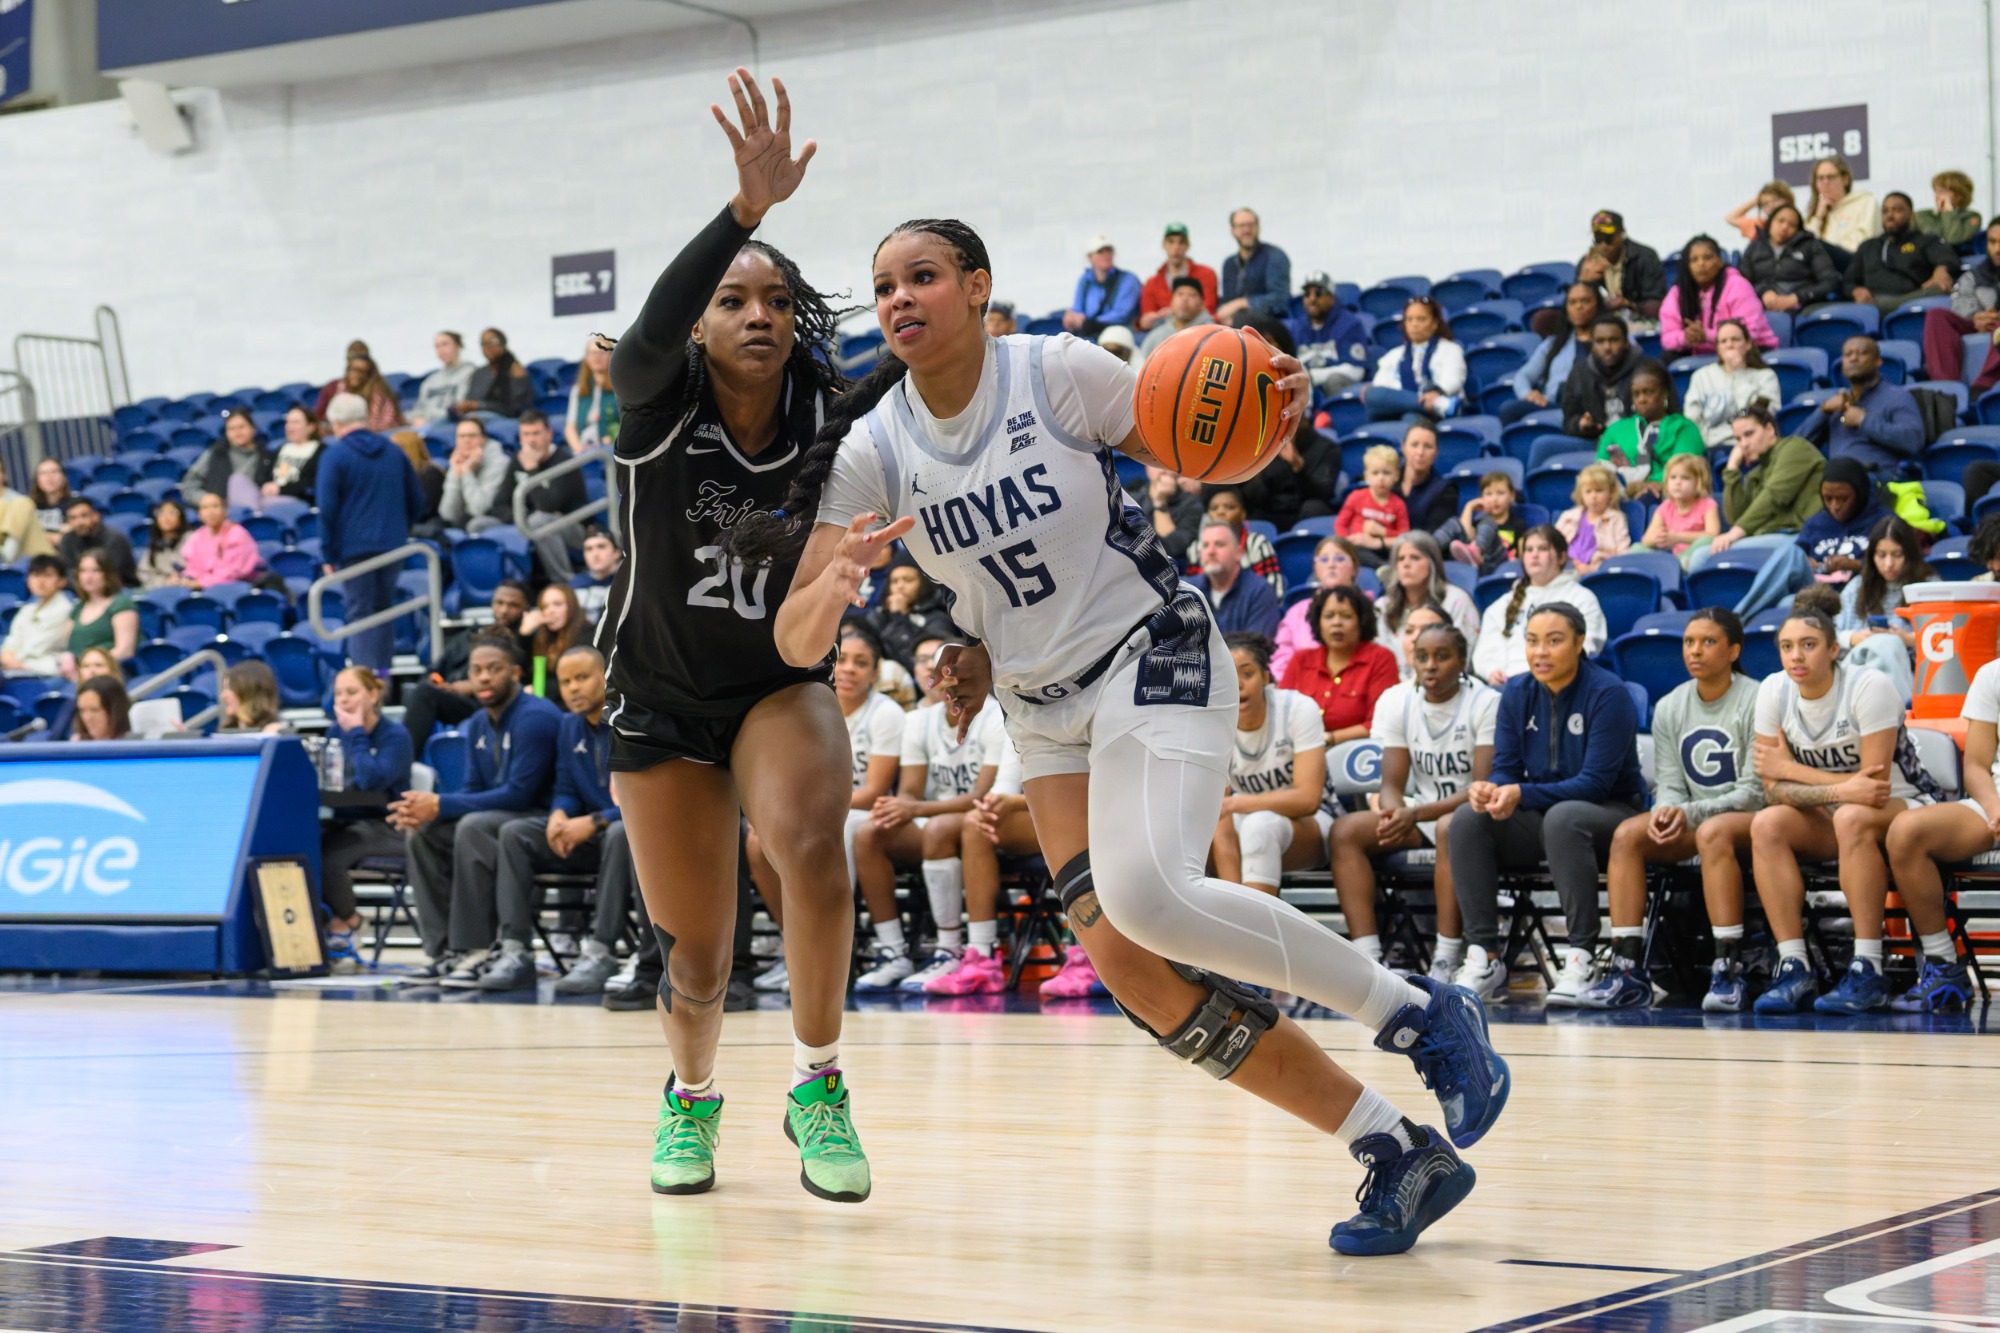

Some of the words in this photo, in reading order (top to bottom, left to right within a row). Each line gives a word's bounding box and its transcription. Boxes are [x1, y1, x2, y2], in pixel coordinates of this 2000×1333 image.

[1779, 132, 1837, 163] SEC.
[1843, 129, 1862, 156] 8
[597, 269, 612, 293] 7
[1190, 358, 1234, 446] ELITE
[698, 423, 709, 431] BE
[1007, 417, 1018, 427] BE
[1018, 411, 1033, 421] THE
[1007, 417, 1036, 435] CHANGE
[693, 430, 721, 441] CHANGE
[1010, 436, 1037, 452] EAST
[1011, 433, 1030, 445] BIG
[919, 463, 1062, 556] HOYAS
[687, 546, 773, 620] 20
[978, 538, 1057, 608] 15
[1922, 621, 1955, 663] G
[1042, 682, 1070, 699] G
[1414, 750, 1472, 777] HOYAS
[1680, 726, 1740, 788] G
[1787, 743, 1861, 768] HOYAS
[931, 762, 980, 787] HOYAS
